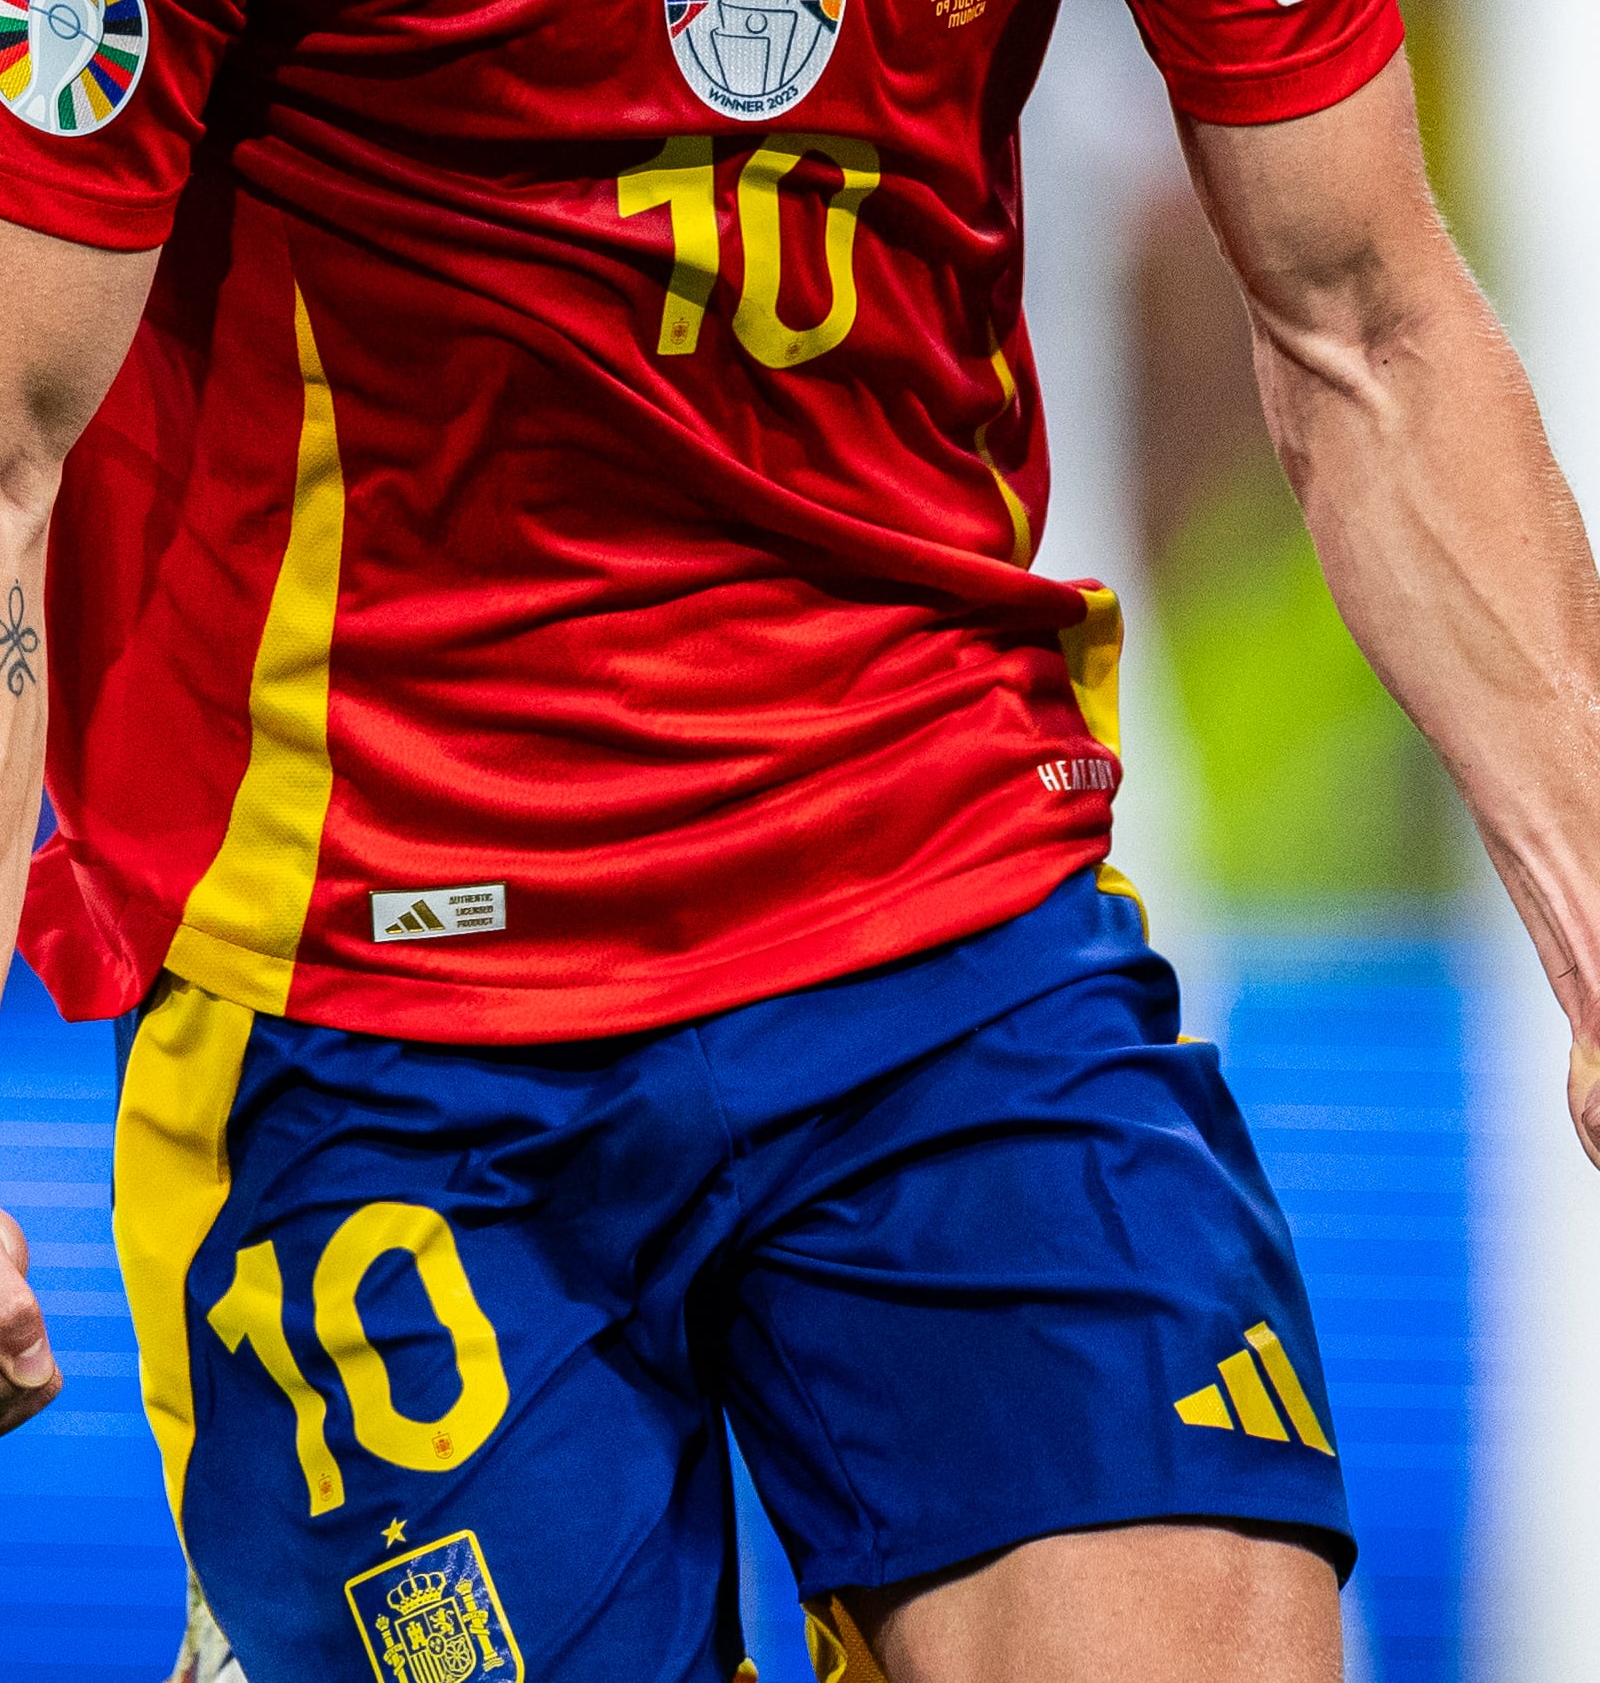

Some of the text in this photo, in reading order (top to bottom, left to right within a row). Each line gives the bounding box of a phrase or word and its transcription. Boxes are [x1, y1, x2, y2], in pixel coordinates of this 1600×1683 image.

[936, 0, 950, 16] 09
[948, 1, 987, 28] MUNICH
[708, 86, 799, 112] WINNER 2023
[617, 132, 881, 369] 10
[206, 1200, 510, 1517] 10
